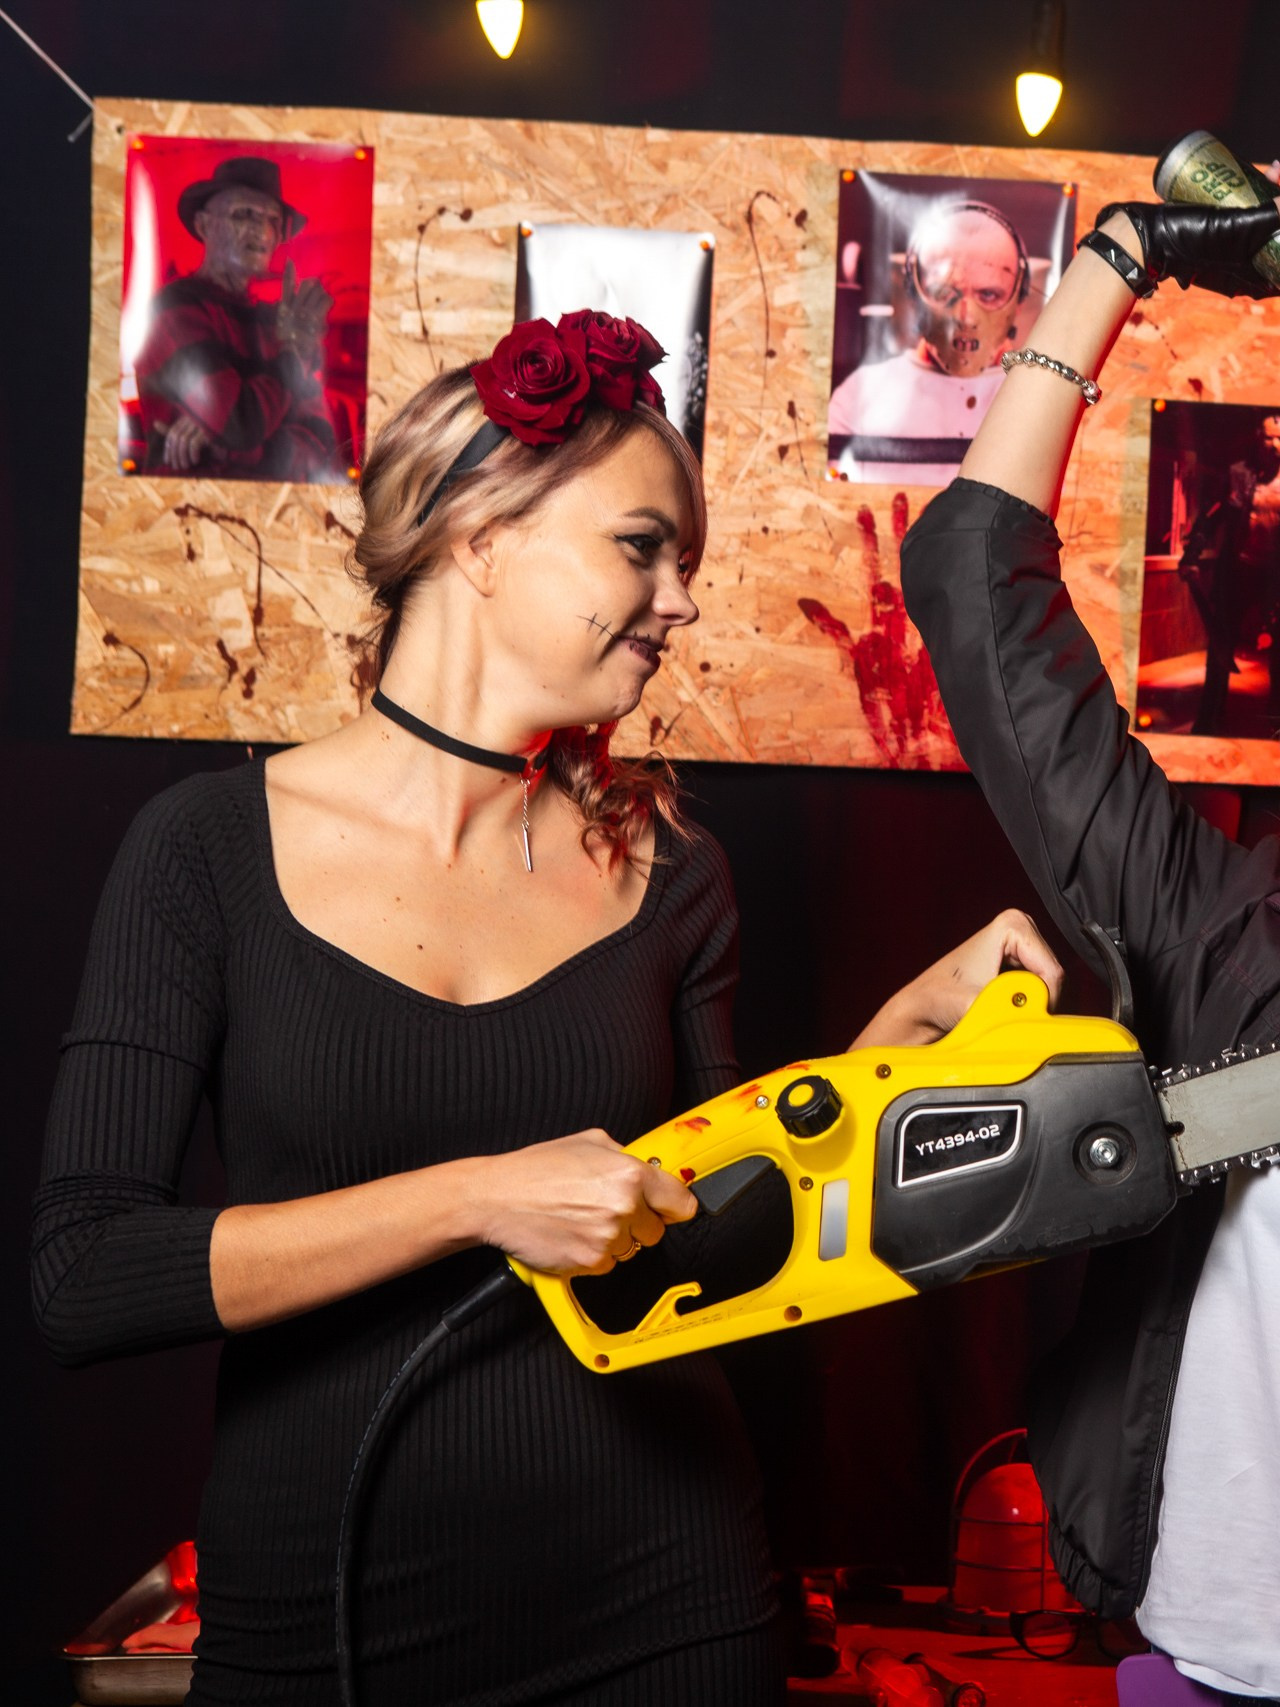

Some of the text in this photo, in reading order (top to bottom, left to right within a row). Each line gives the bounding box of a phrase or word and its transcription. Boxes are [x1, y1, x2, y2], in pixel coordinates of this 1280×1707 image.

[1190, 169, 1232, 200] PRO
[1206, 162, 1245, 188] CUP
[915, 1124, 1001, 1157] YT4394-02
